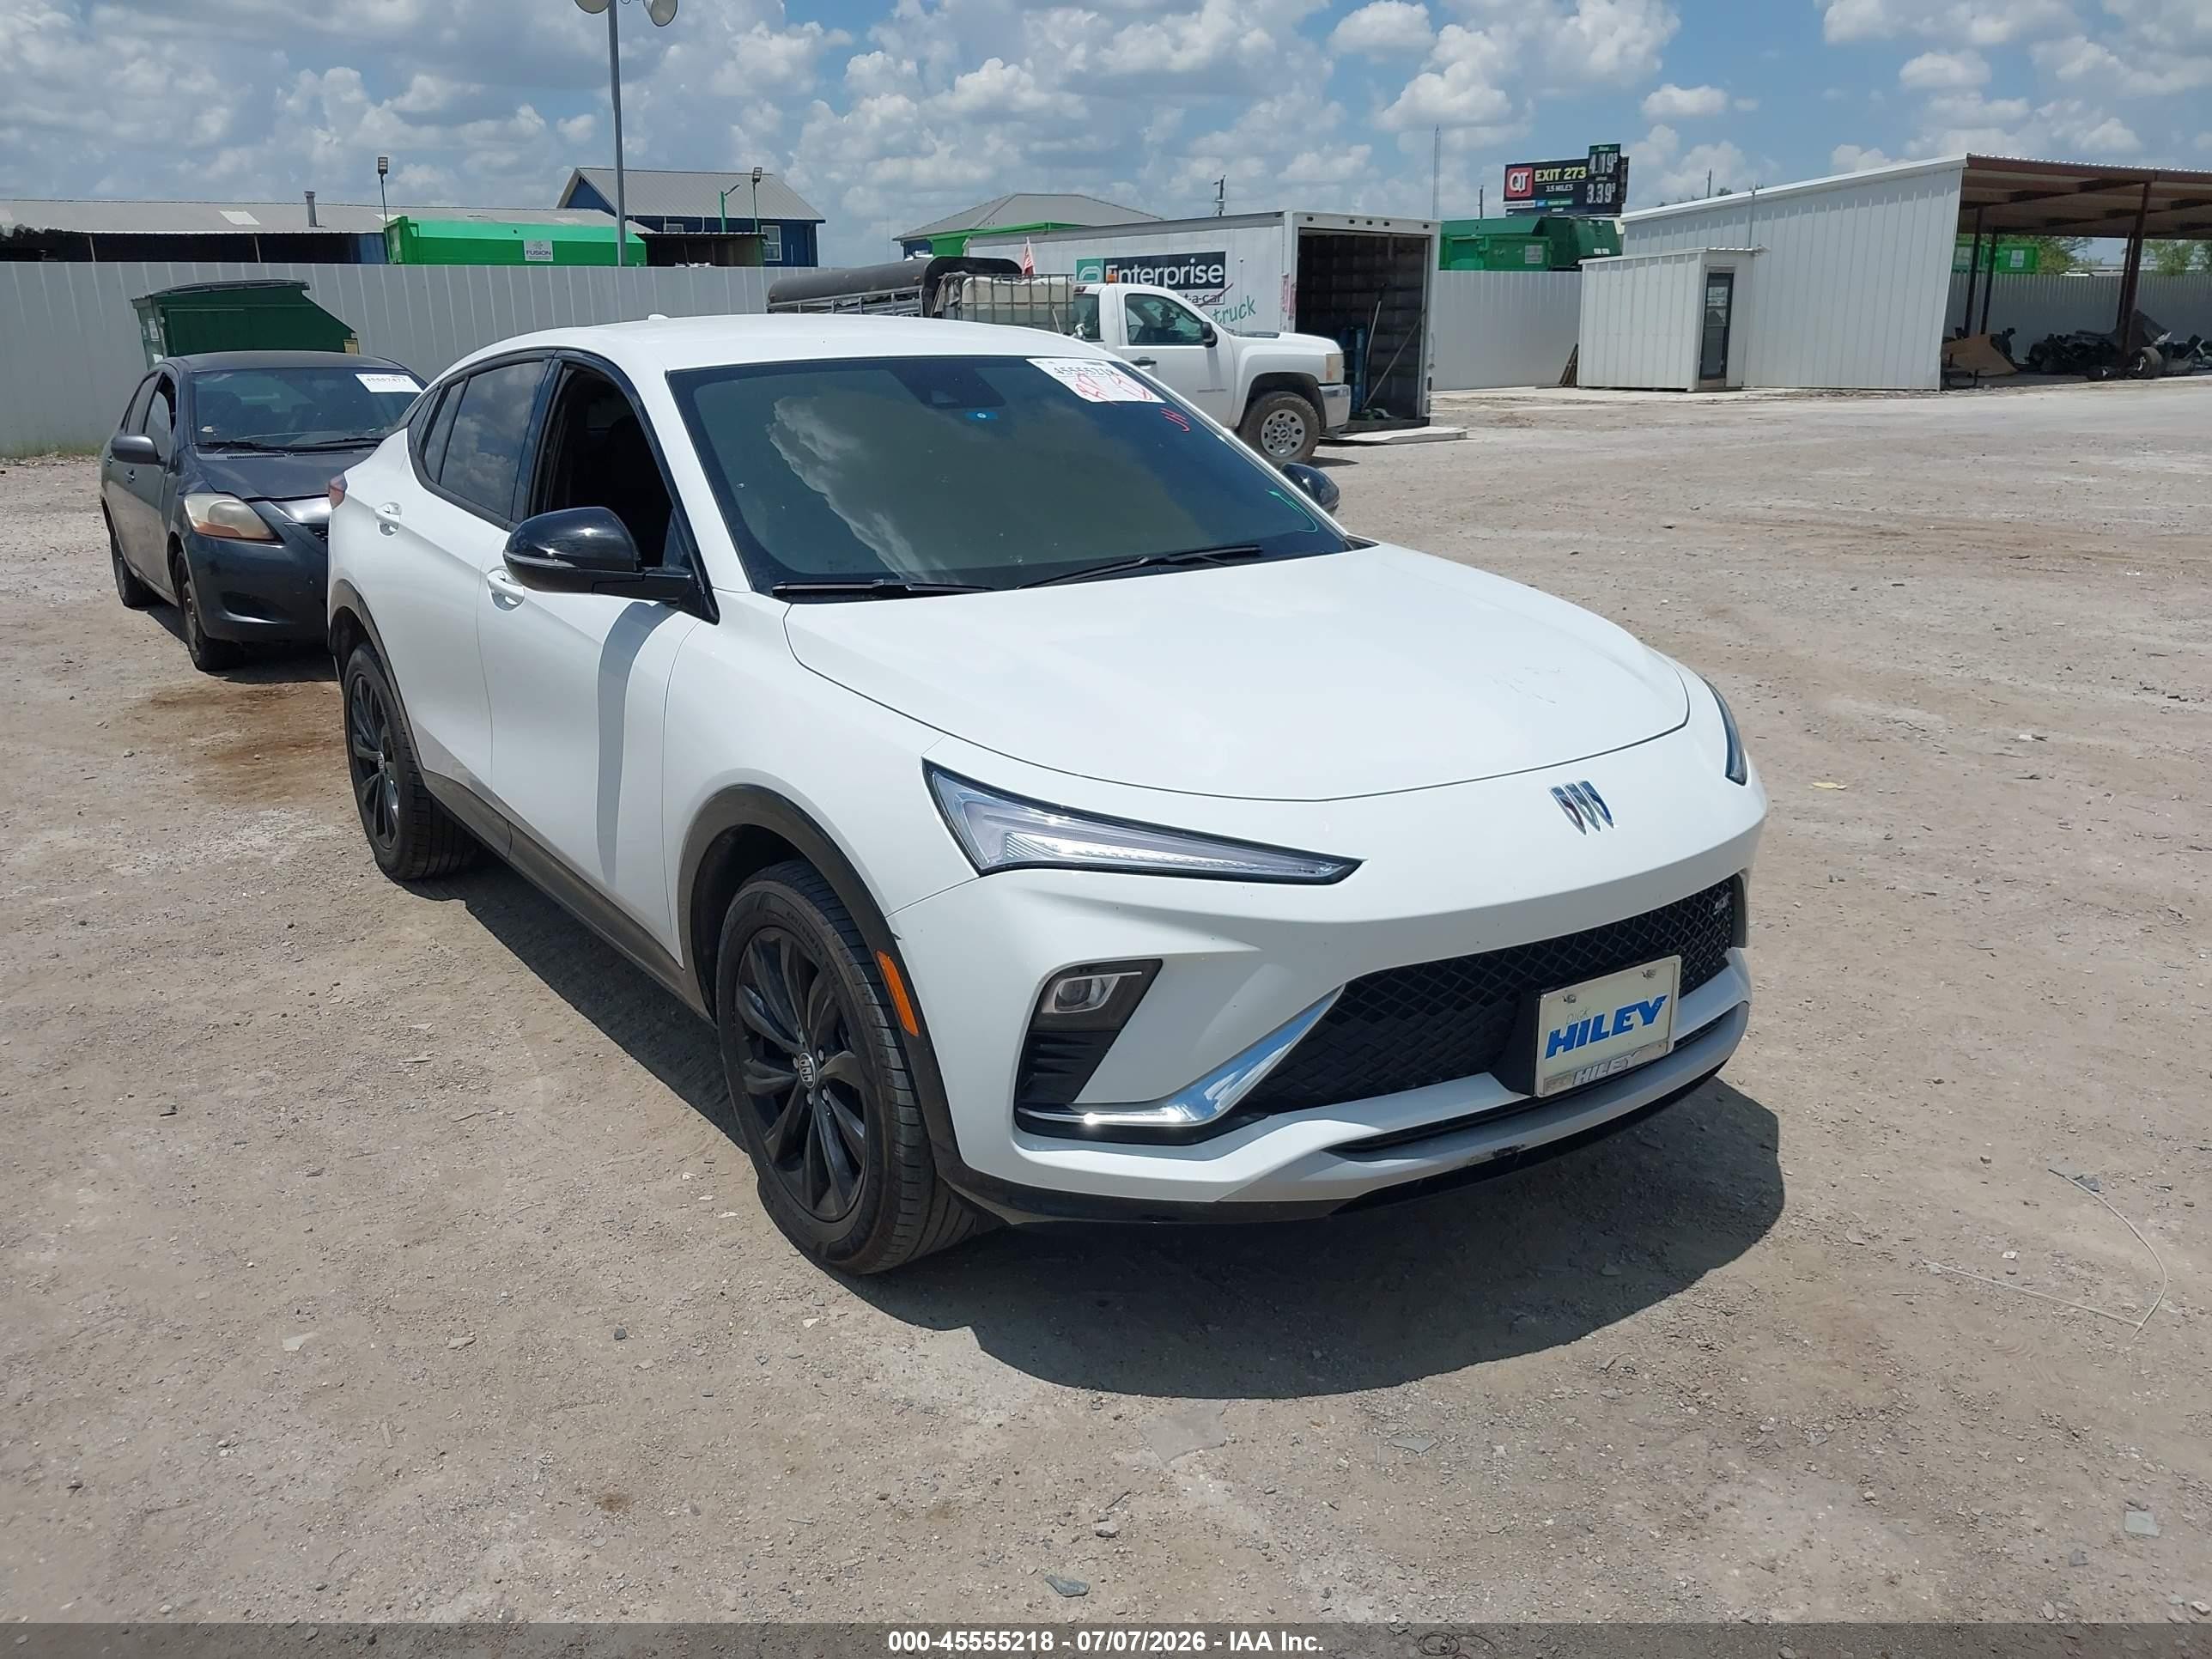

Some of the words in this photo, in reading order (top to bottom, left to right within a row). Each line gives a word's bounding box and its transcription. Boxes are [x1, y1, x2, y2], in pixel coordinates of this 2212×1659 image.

[1510, 172, 1528, 192] QT
[1534, 168, 1561, 182] EXIT
[1564, 167, 1586, 179] 273
[1105, 258, 1224, 289] Enterprise
[1212, 295, 1256, 324] truck
[1545, 994, 1668, 1060] HILEY
[1573, 1050, 1642, 1086] HILEY
